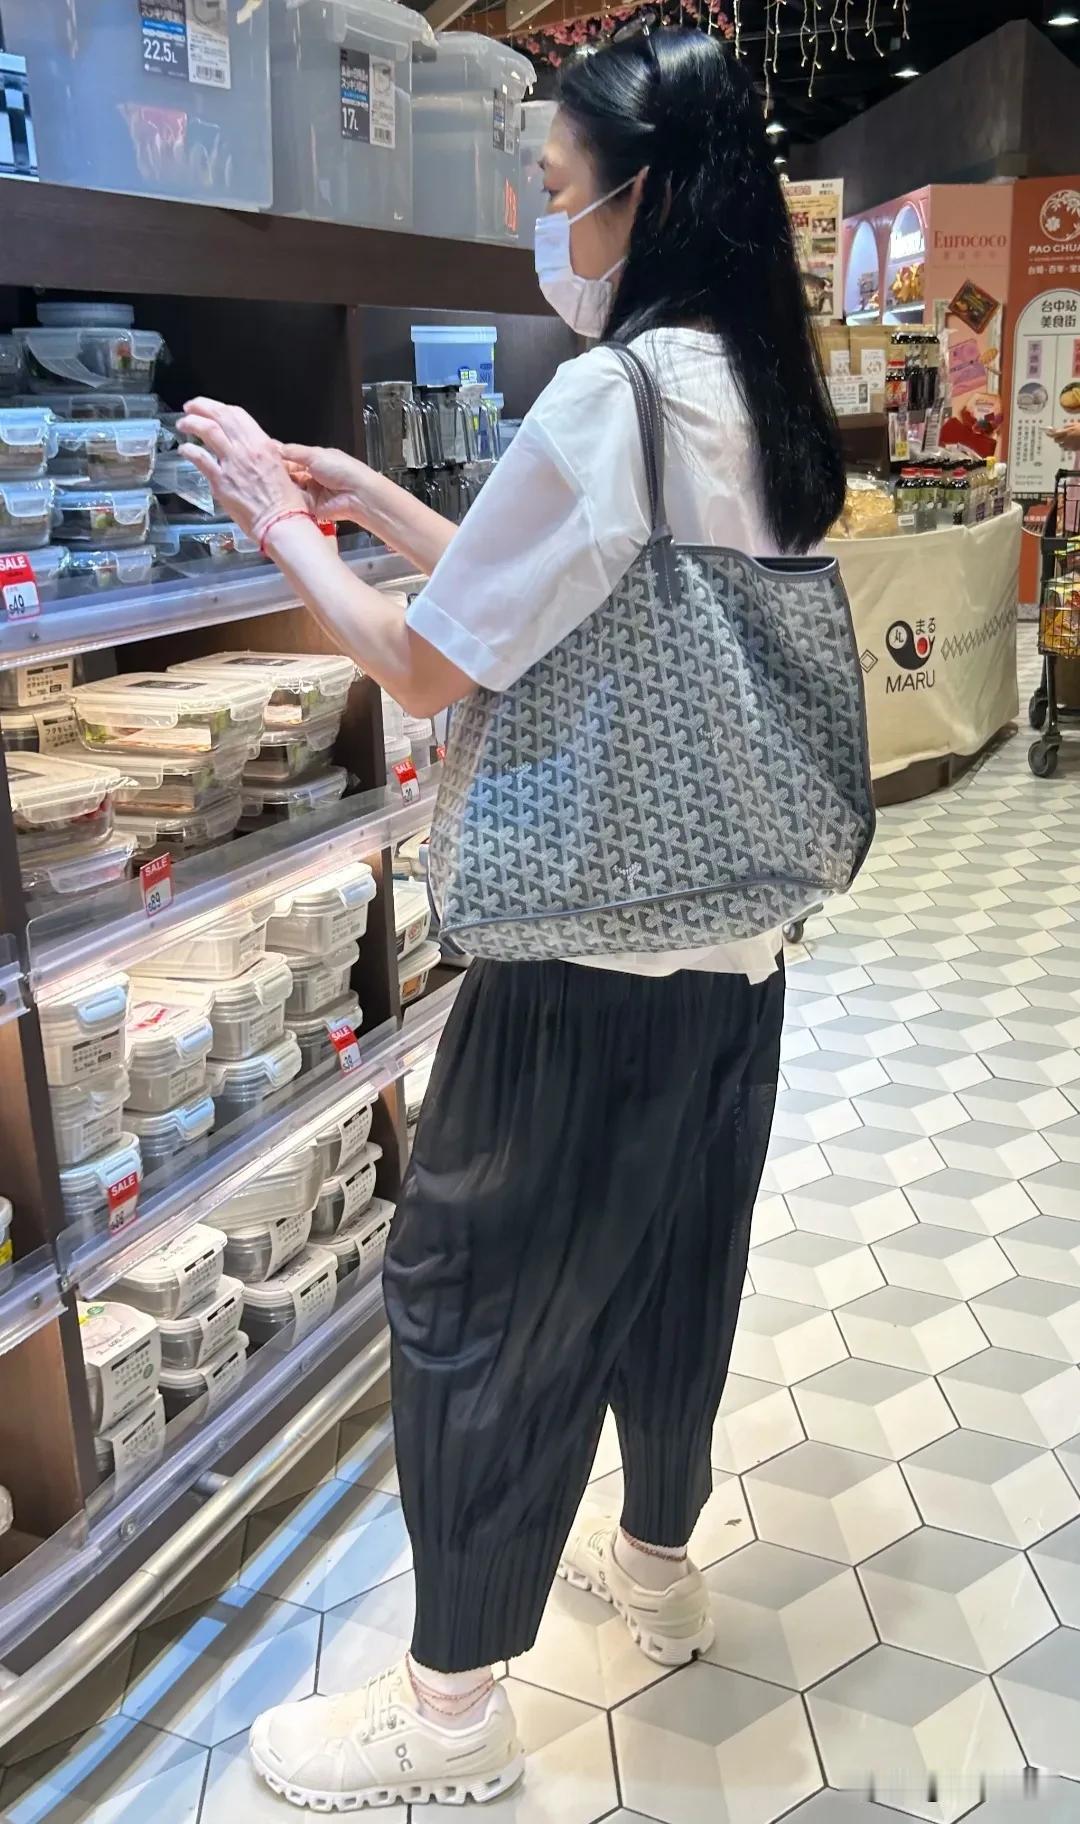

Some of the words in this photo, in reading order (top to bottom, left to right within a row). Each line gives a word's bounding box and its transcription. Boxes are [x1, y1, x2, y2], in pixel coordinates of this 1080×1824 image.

[342, 107, 359, 131] 17L
[933, 230, 1007, 249] Eurococo
[1029, 245, 1051, 254] PAO
[1041, 300, 1077, 313] 台中站
[1041, 315, 1077, 328] 美食街
[0, 555, 27, 571] SALE
[915, 617, 936, 635] まる
[886, 669, 936, 694] MARU
[145, 856, 169, 876] SALE
[110, 1175, 136, 1197] SALE
